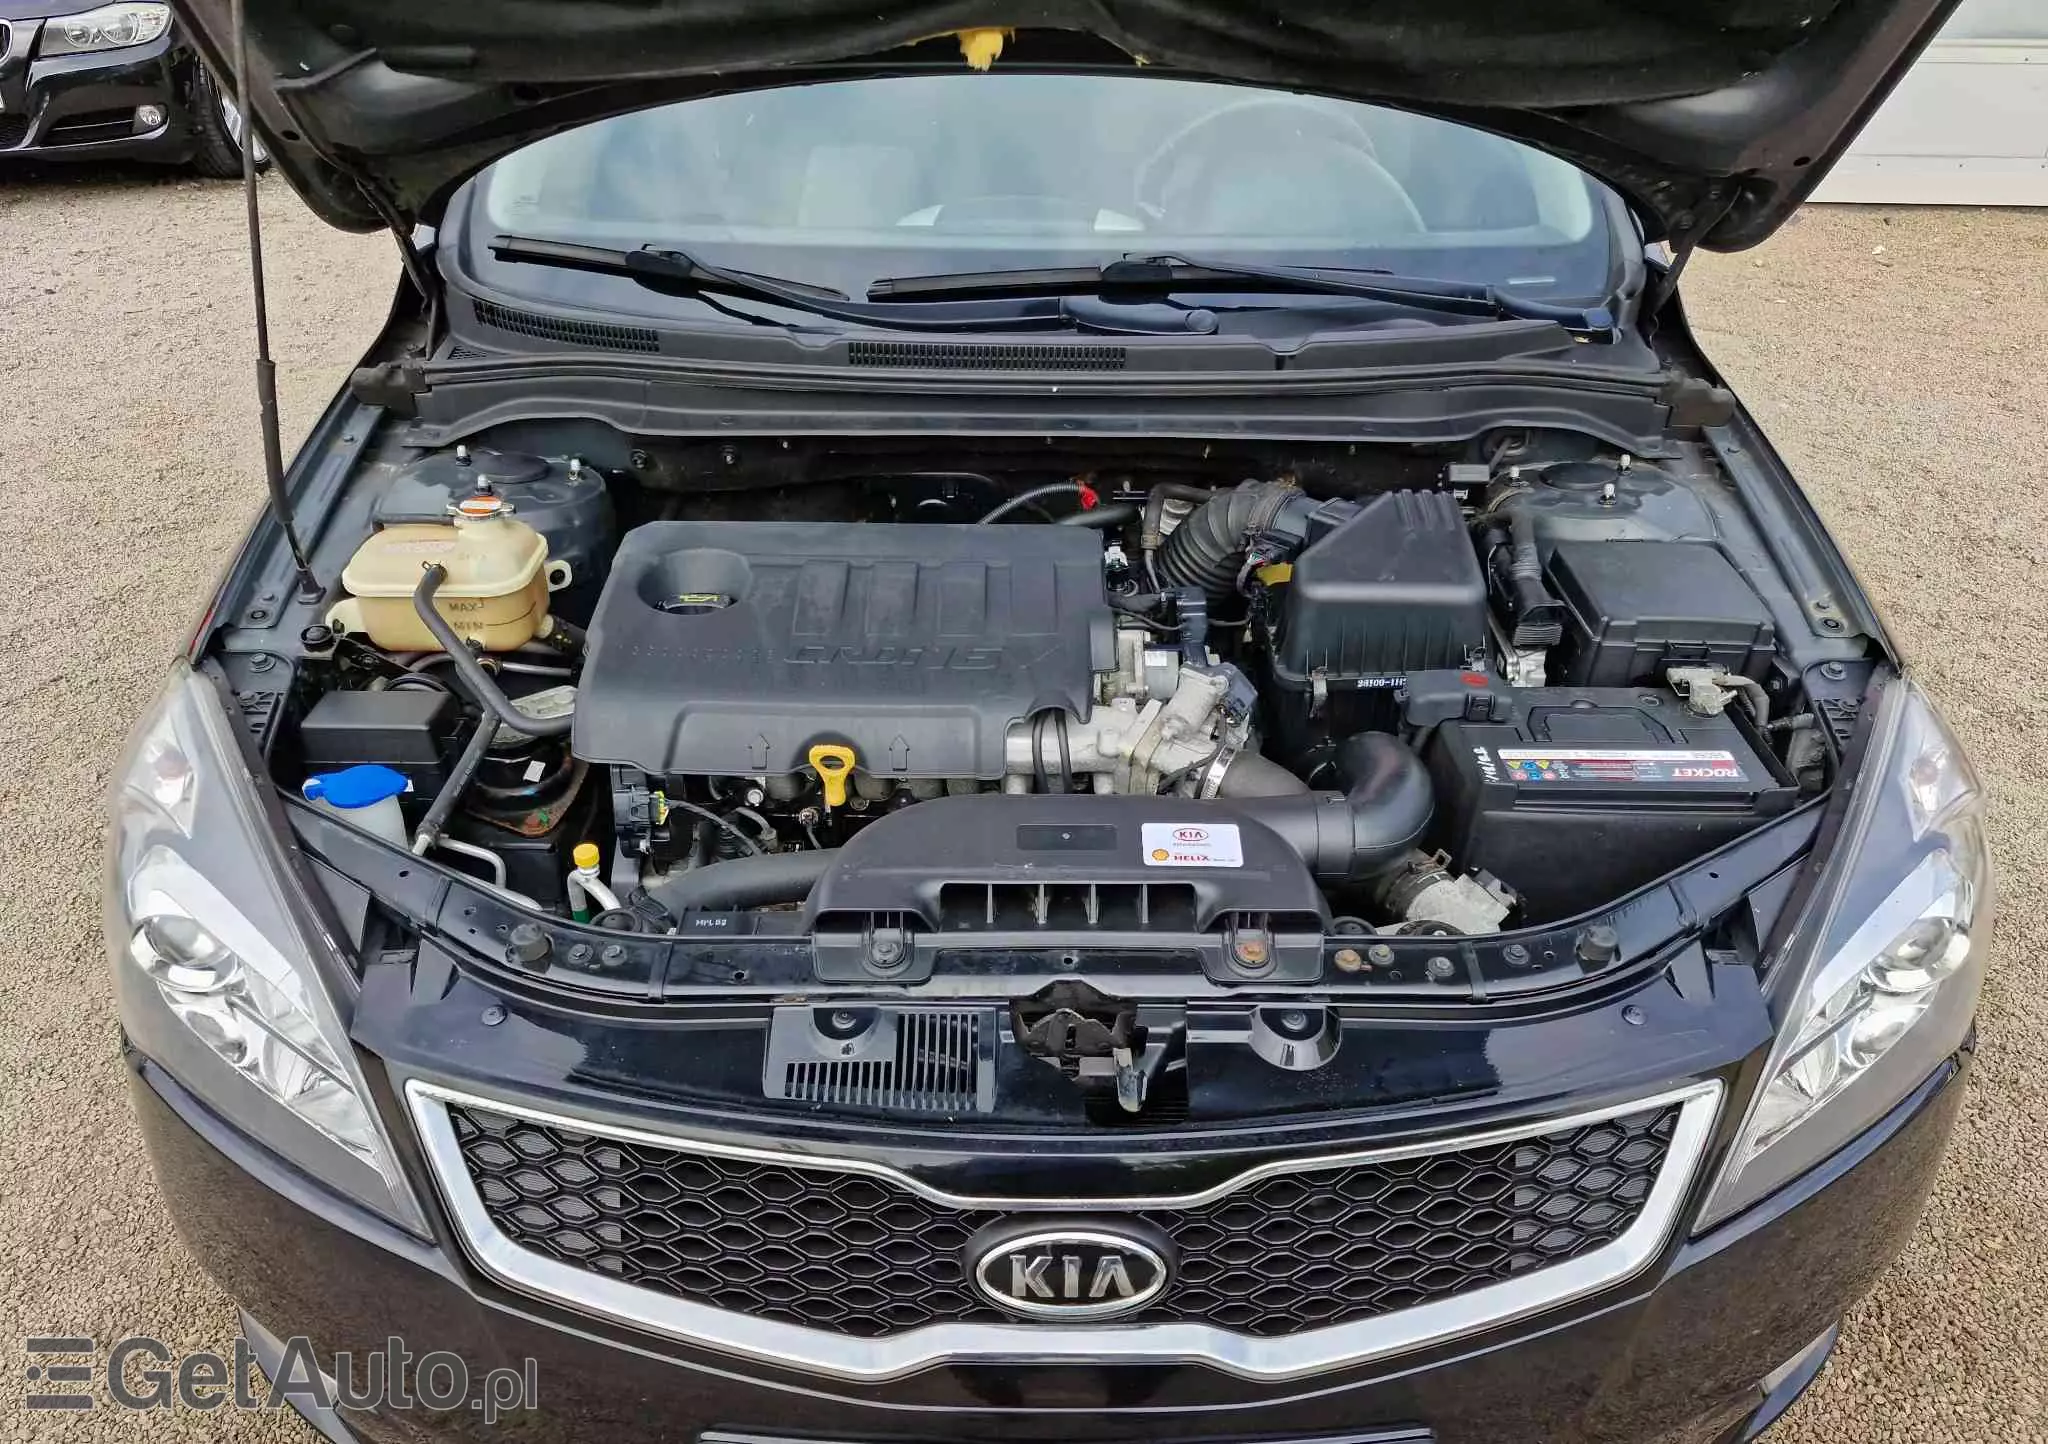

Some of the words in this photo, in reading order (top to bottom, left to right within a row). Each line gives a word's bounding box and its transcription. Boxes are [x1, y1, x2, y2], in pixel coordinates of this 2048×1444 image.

[449, 602, 477, 612] MAX
[1671, 766, 1741, 778] ROCKET
[1178, 830, 1203, 839] KIA
[1009, 1254, 1136, 1299] KIA
